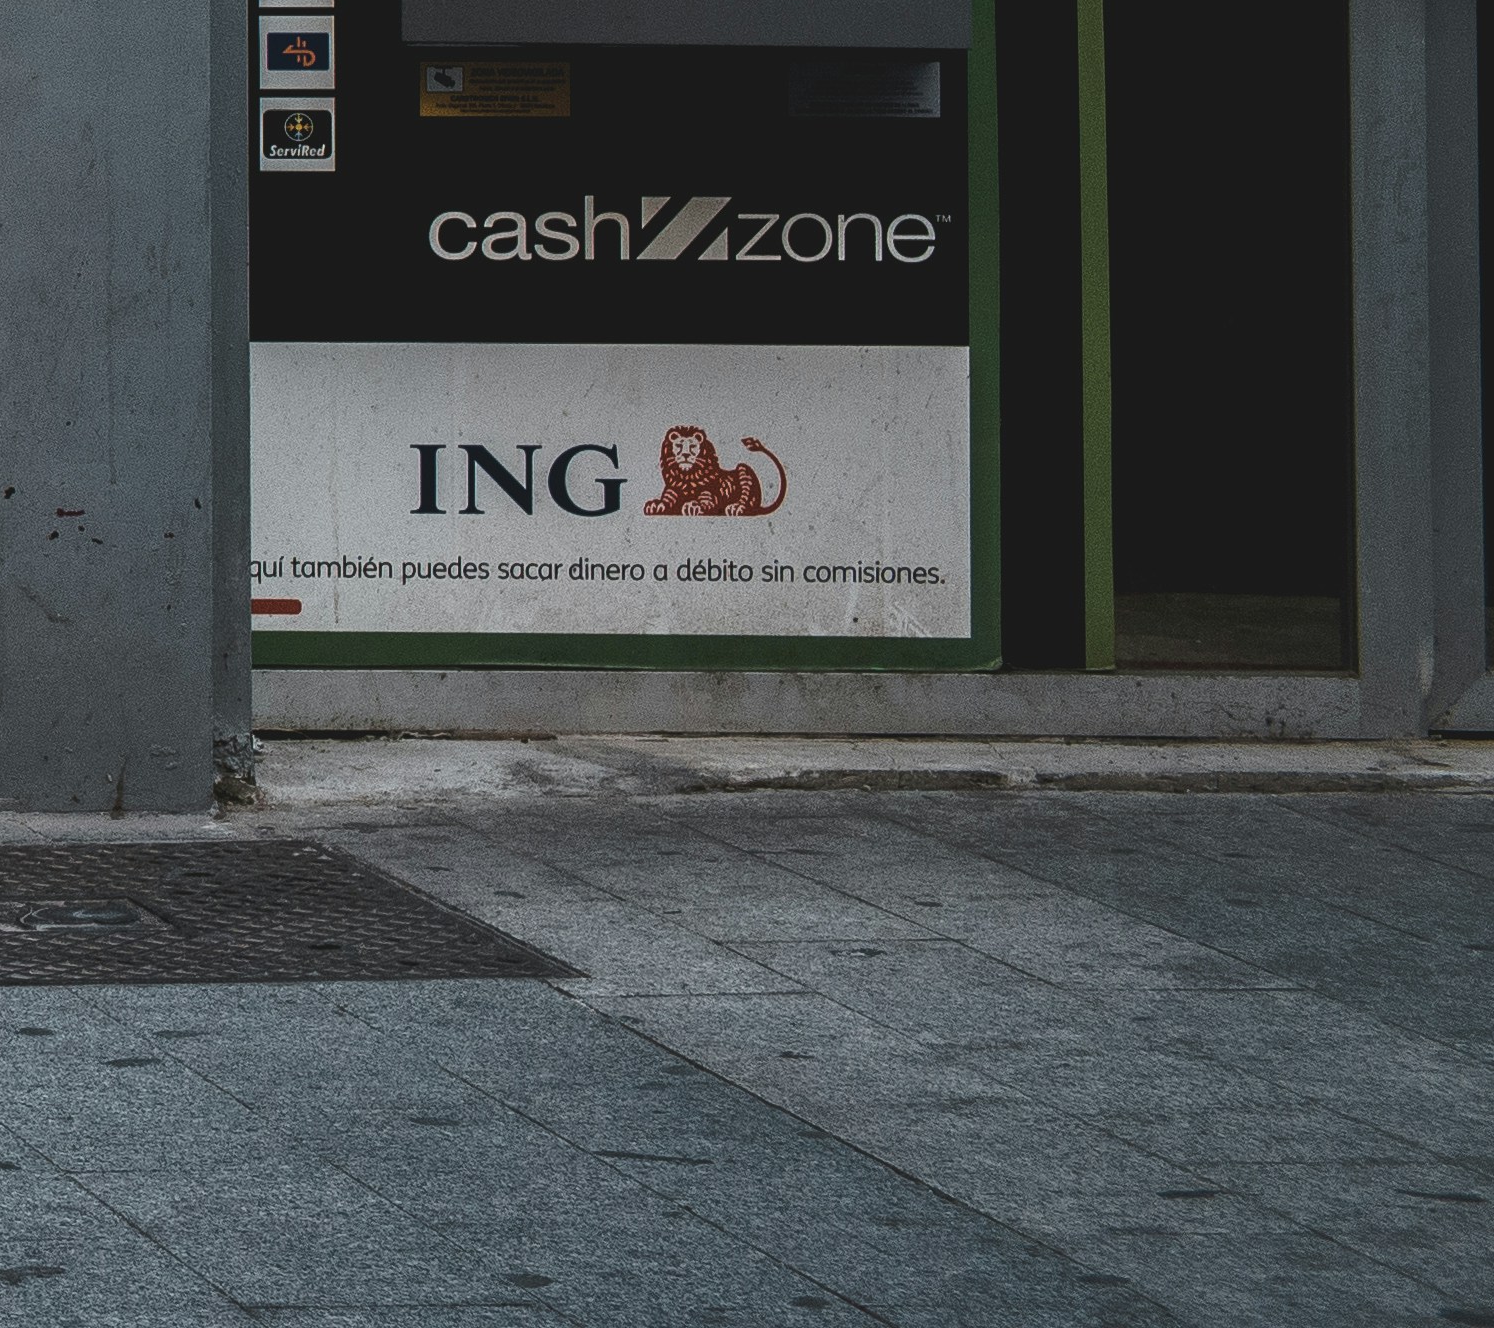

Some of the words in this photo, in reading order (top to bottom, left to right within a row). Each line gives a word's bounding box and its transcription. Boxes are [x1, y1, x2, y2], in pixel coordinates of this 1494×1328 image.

[269, 144, 326, 157] ServiRed
[409, 443, 628, 518] ING
[250, 556, 284, 584] quí
[291, 555, 393, 579] también
[402, 556, 490, 585] puedes
[498, 561, 563, 581] sacar
[568, 557, 645, 581] dinero
[653, 563, 669, 582] a
[676, 558, 753, 582] débito
[761, 559, 794, 582] sin
[803, 560, 946, 585] comisiones.
